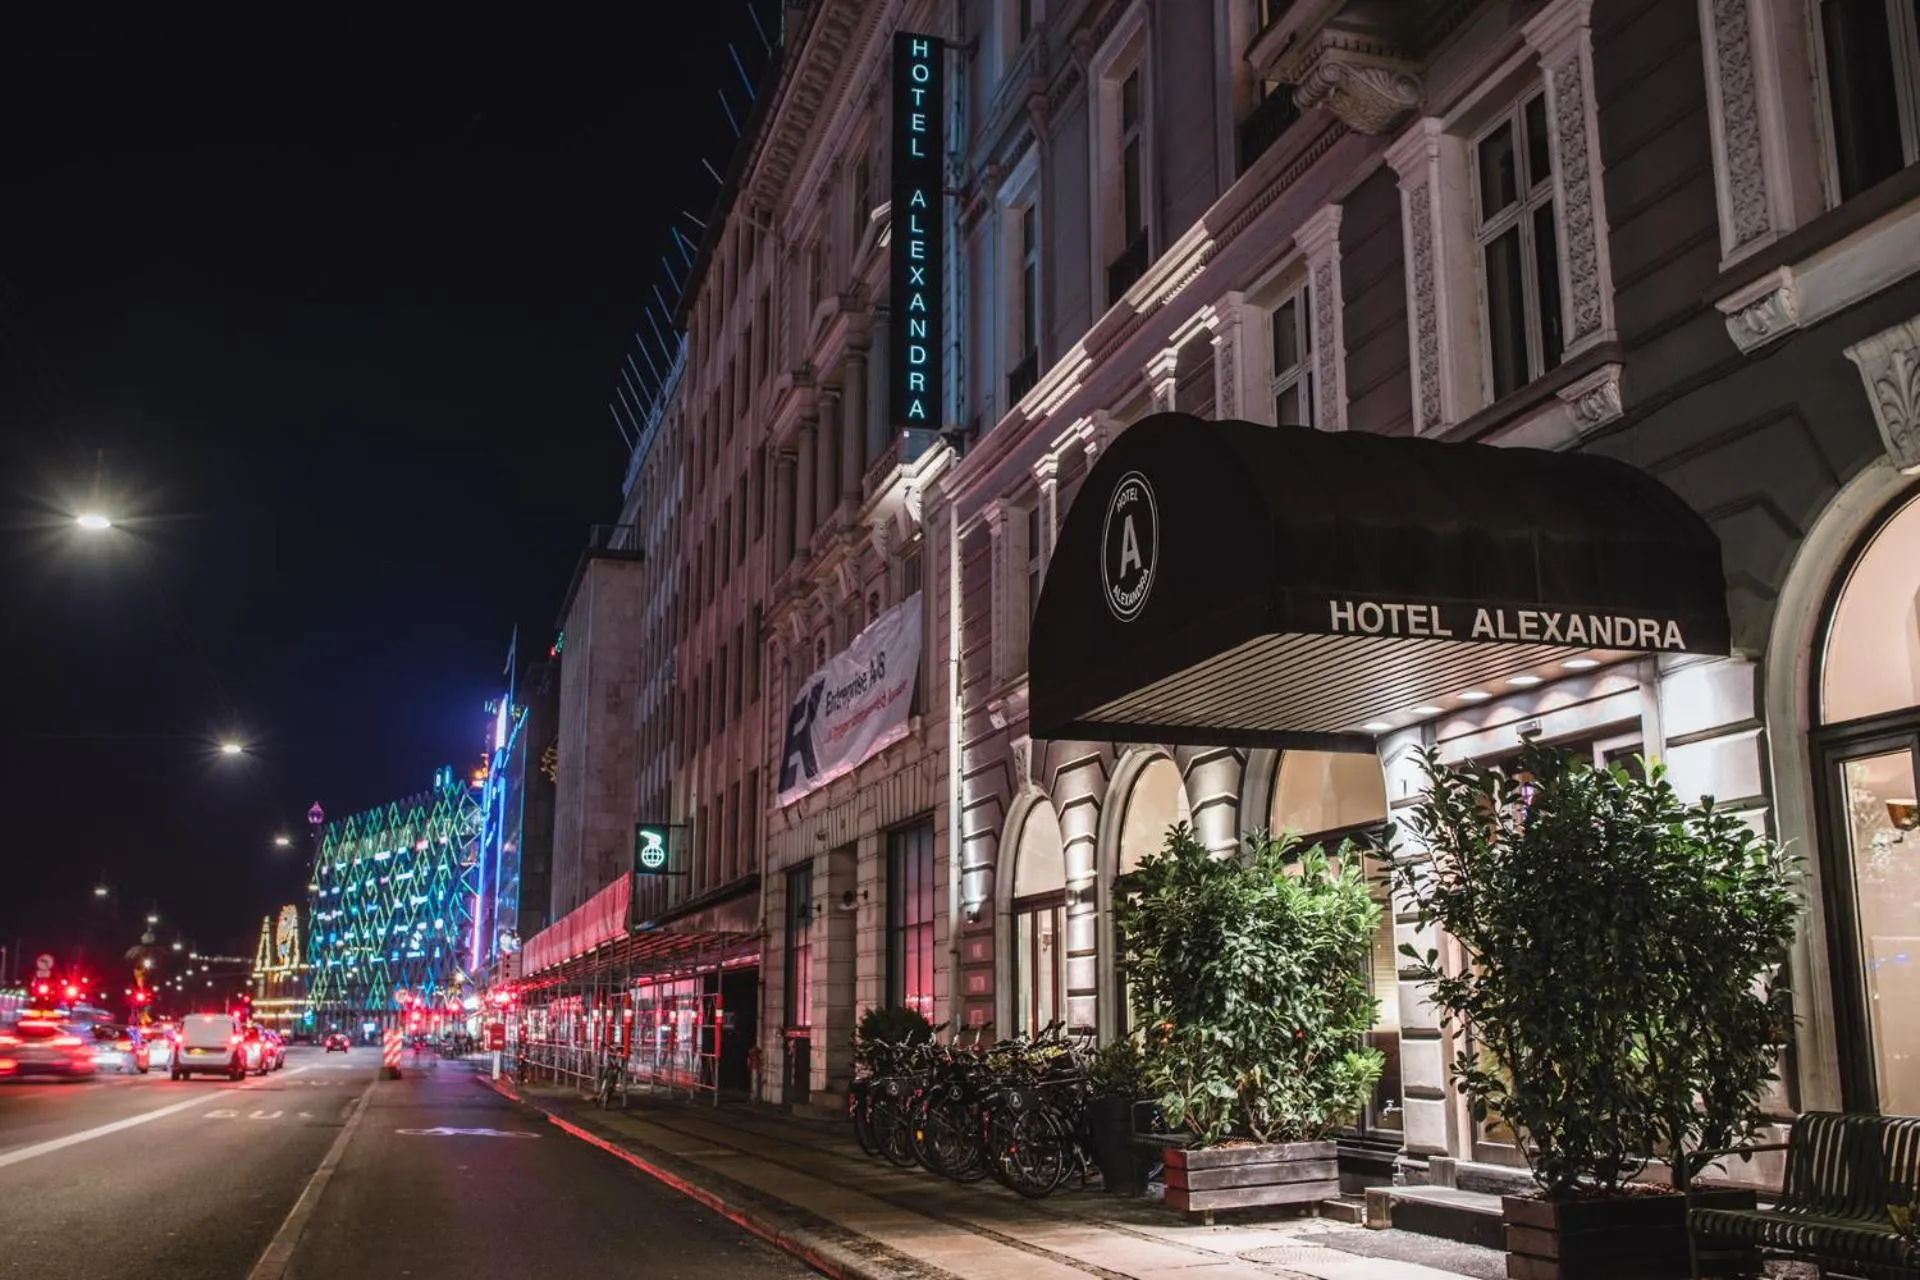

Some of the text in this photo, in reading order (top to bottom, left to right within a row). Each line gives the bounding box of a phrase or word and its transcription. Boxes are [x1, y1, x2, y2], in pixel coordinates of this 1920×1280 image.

[908, 39, 930, 419] HOTEL ALEXANDRA
[1117, 487, 1138, 513] HOTEL
[1119, 514, 1142, 579] A
[1112, 568, 1150, 606] ALEXANDRA
[1330, 599, 1687, 651] HOTEL ALEXANDRA
